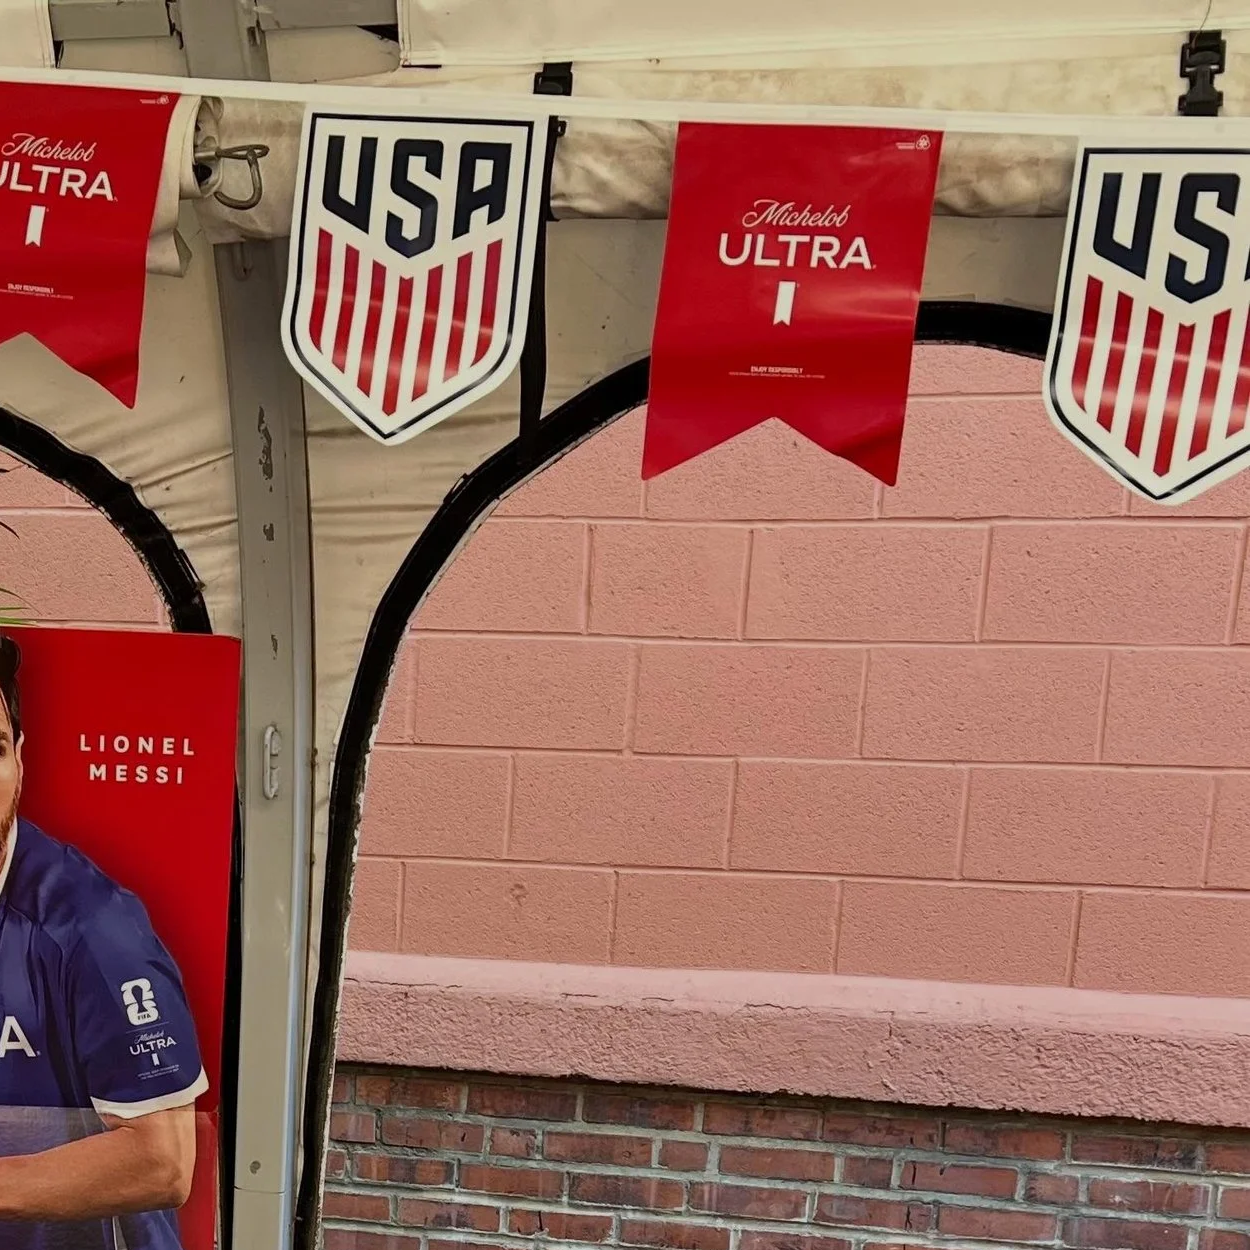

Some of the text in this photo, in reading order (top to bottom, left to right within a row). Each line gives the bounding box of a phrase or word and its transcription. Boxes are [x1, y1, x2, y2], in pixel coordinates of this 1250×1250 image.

[0, 132, 95, 163] Michelob
[321, 134, 514, 259] USA
[741, 198, 852, 228] Michelob
[718, 232, 874, 270] ULTRA
[1092, 171, 1250, 304] US
[79, 734, 194, 756] LIONEL
[89, 763, 183, 784] MESSI
[129, 1036, 178, 1055] ULTRA
